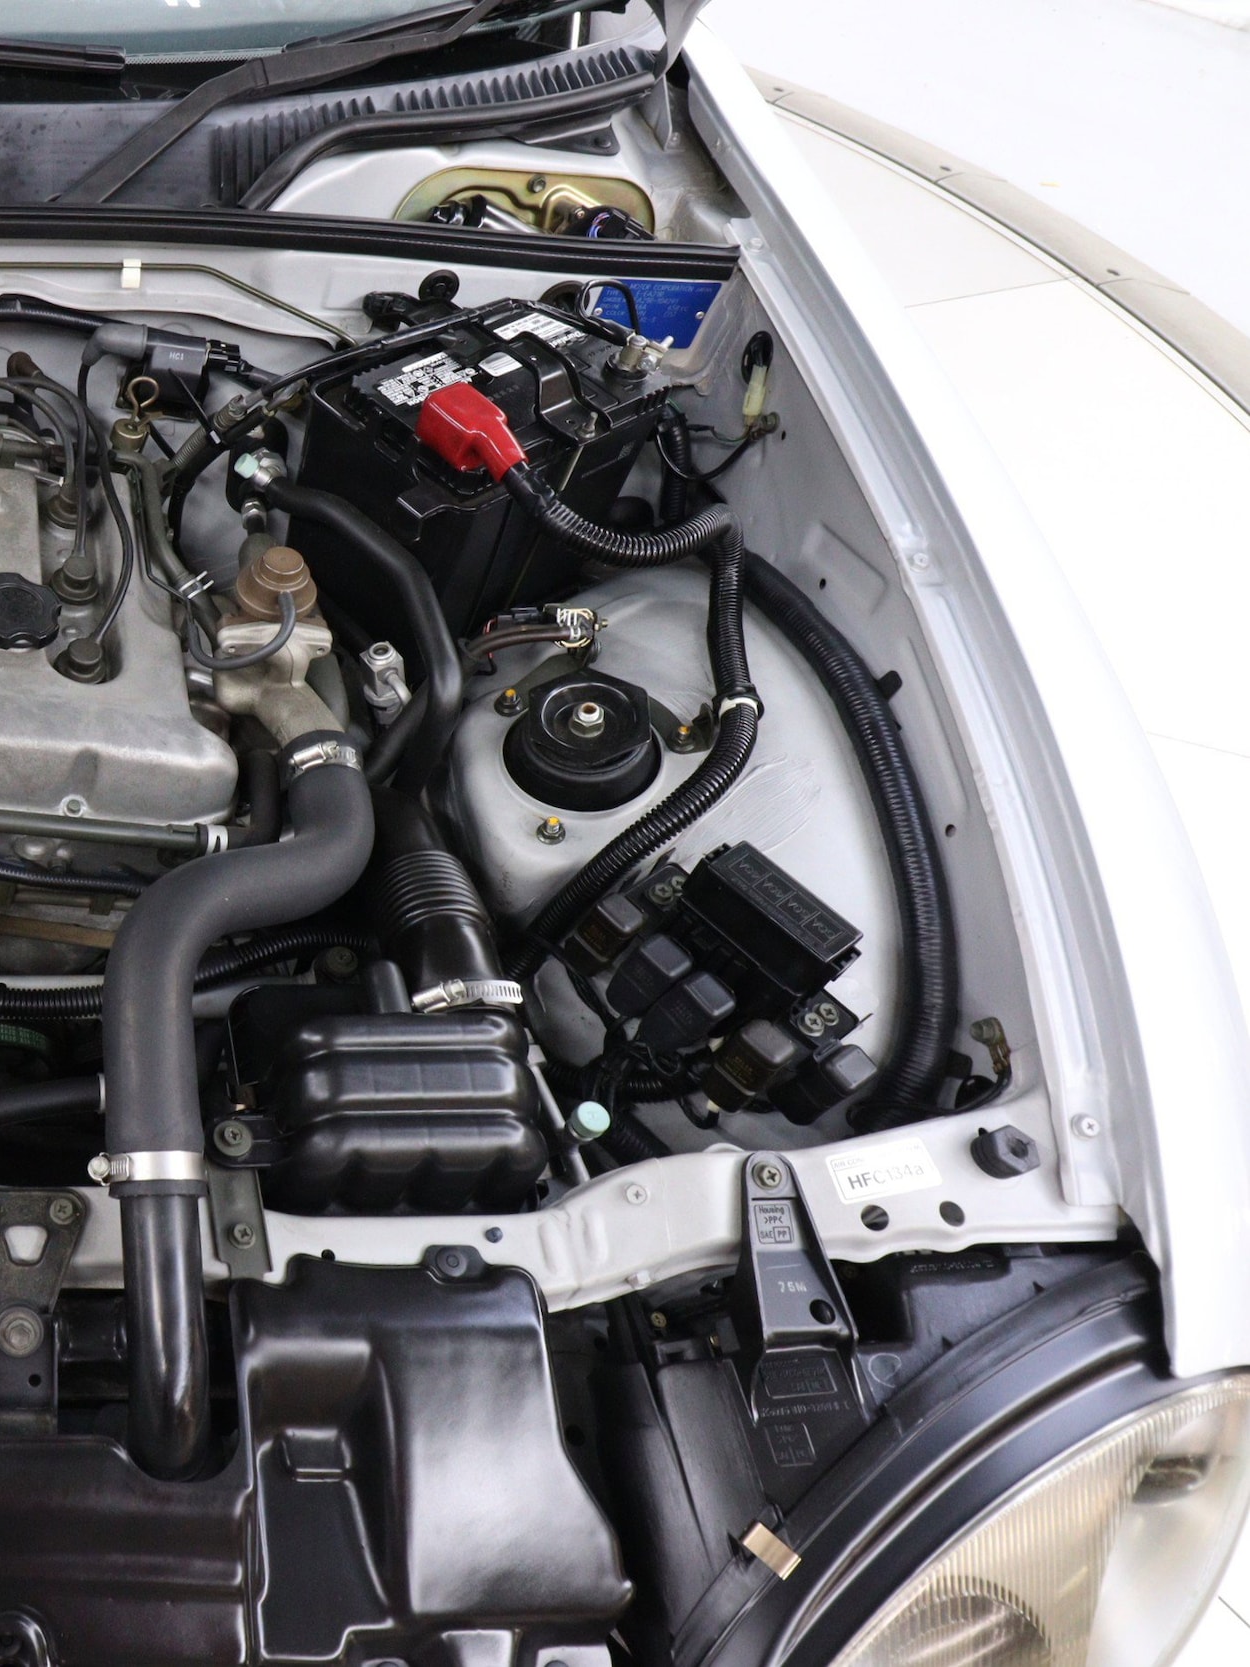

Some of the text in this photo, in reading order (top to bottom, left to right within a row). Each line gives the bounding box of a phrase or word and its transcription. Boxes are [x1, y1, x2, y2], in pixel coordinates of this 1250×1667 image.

[847, 1164, 925, 1190] HFC134a
[758, 1205, 785, 1216] Housing
[759, 1229, 787, 1239] SAE PP
